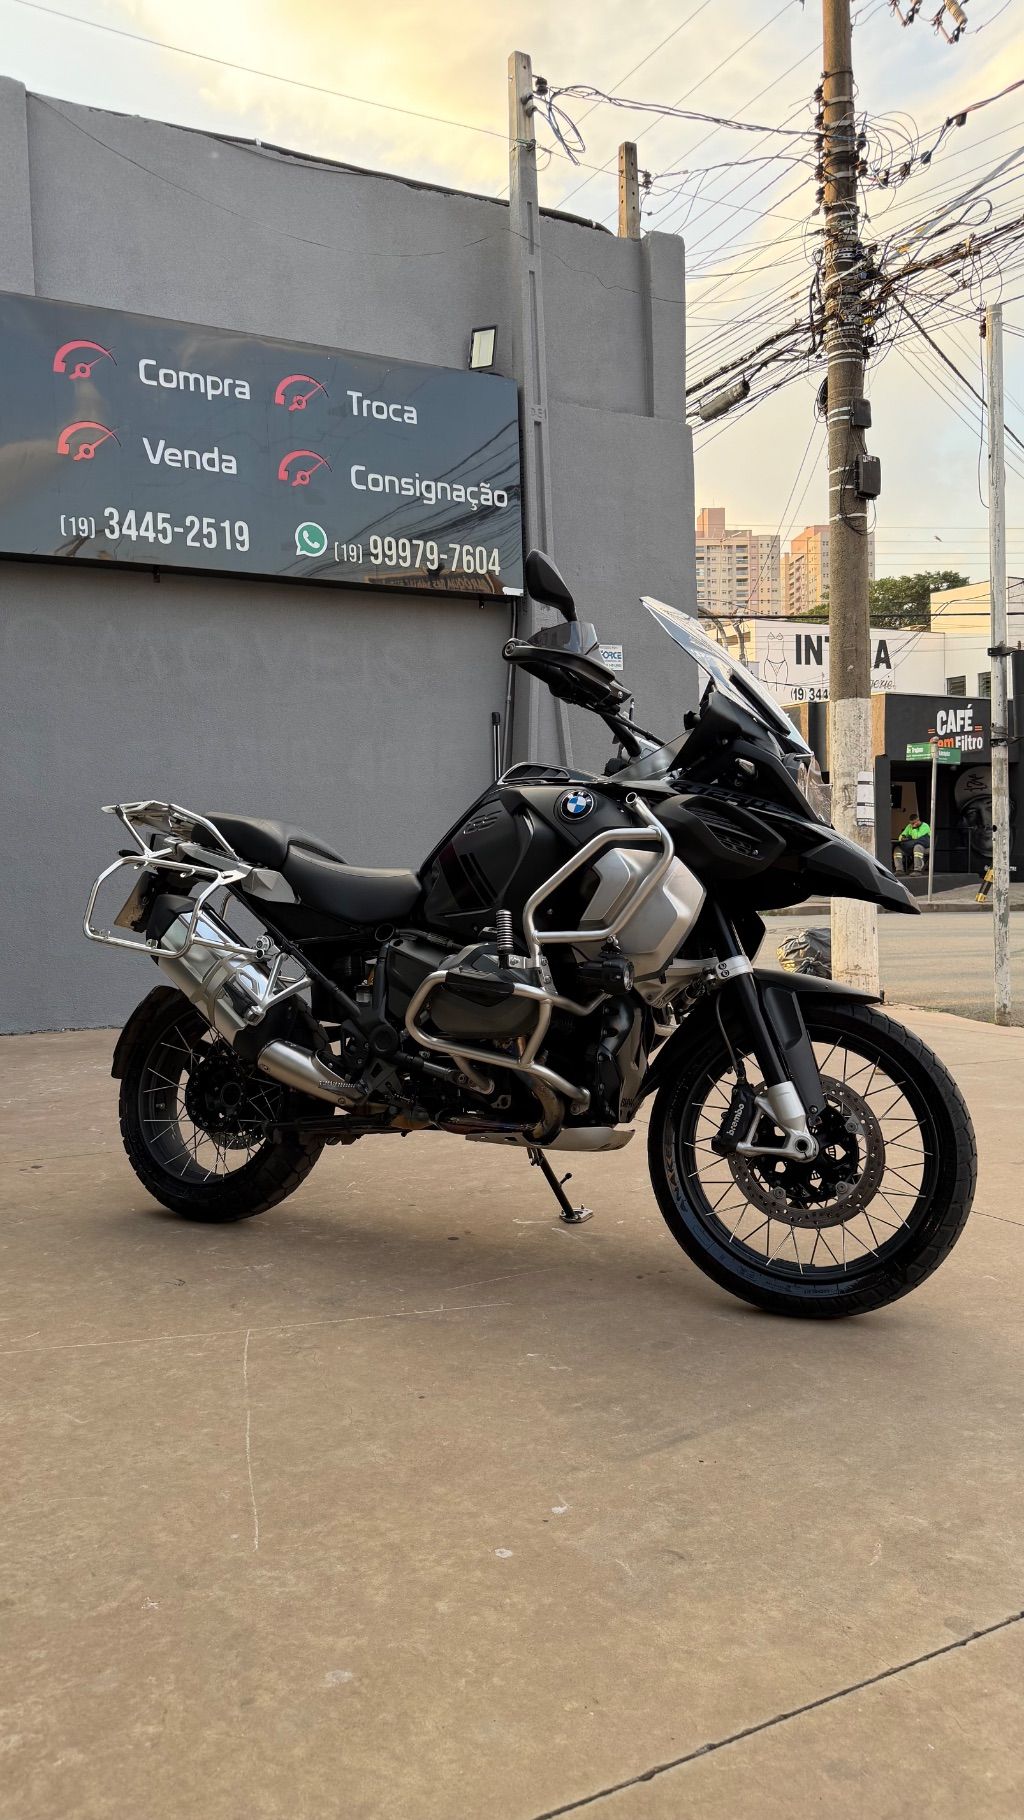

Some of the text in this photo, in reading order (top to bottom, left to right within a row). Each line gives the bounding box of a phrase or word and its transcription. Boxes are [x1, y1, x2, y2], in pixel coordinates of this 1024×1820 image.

[138, 358, 251, 401] Compra
[346, 390, 418, 425] Troca
[142, 437, 238, 475] Venda
[350, 464, 508, 511] Consignação
[60, 506, 250, 552] (19) 3445-2519
[334, 534, 501, 576] (19) 99979-7604
[790, 687, 807, 701] (19)
[936, 703, 974, 736] CAFÉ
[955, 734, 984, 752] Filtro
[726, 1103, 745, 1137] brembo
